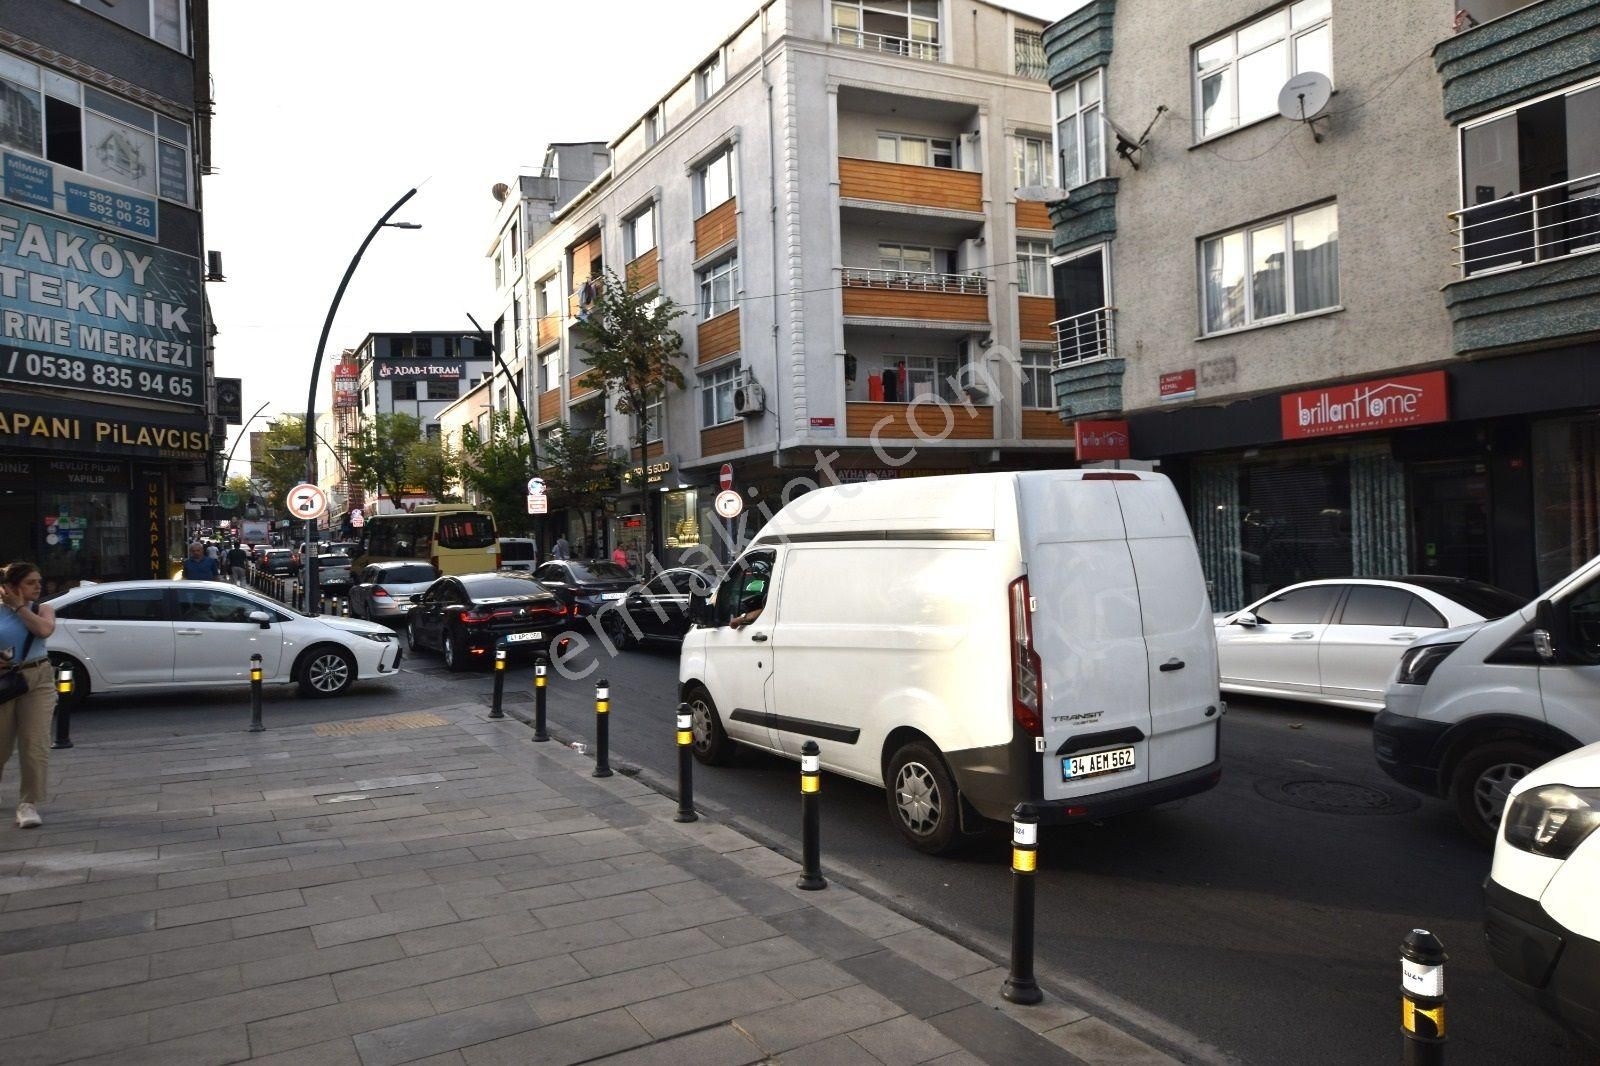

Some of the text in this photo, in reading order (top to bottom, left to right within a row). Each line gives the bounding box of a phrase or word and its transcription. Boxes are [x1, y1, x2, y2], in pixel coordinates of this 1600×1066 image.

[89, 191, 112, 206] 592
[116, 199, 131, 211] 00
[135, 205, 150, 217] 22
[89, 202, 150, 228] 592 00 20
[0, 215, 152, 286] FAKÖY
[0, 265, 191, 334] TEKNİK
[80, 325, 193, 368] MERKEZİ
[26, 354, 86, 382] 0538
[92, 364, 133, 389] 835
[138, 372, 164, 393] 94
[169, 377, 193, 397] 65
[0, 412, 79, 440] APANI
[68, 474, 105, 484] YAPILIR
[1051, 710, 1104, 722] TRANSIT
[1071, 750, 1131, 774] 34 AEM 562
